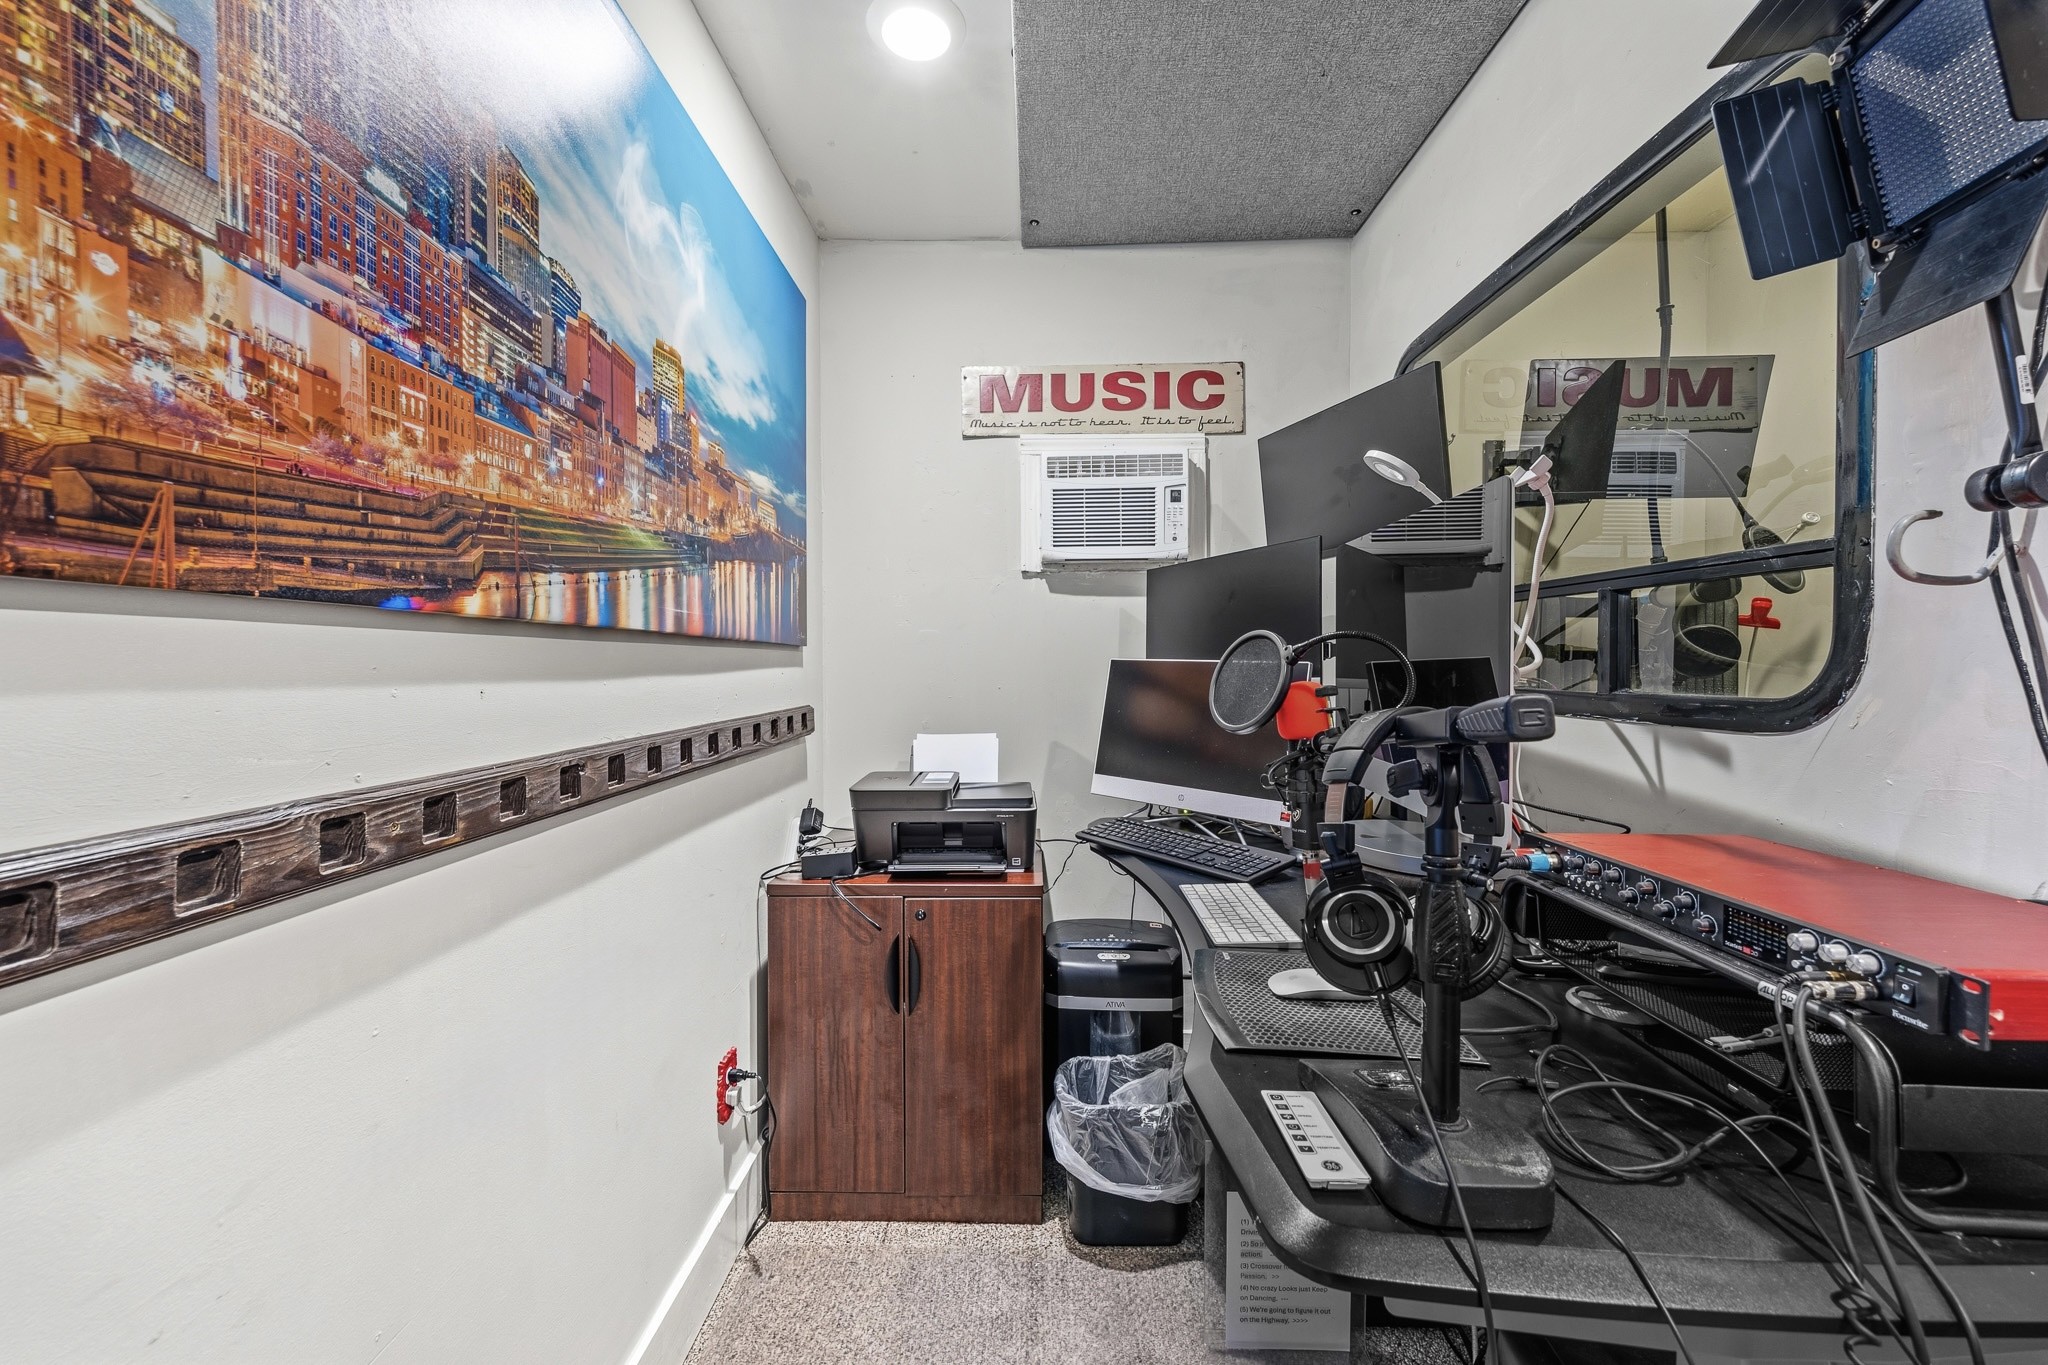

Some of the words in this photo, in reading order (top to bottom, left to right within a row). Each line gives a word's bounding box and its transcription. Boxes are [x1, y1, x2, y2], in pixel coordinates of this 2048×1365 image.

[979, 369, 1226, 413] MUSIC
[970, 418, 1017, 428] Music
[1019, 419, 1037, 428] is
[1040, 418, 1067, 427] not
[1069, 418, 1087, 427] to
[1089, 417, 1131, 426] hear.
[1140, 416, 1157, 425] It
[1158, 416, 1176, 425] is
[1177, 416, 1196, 425] to
[1197, 415, 1235, 432] feel.
[1759, 985, 1794, 1003] ALLOP
